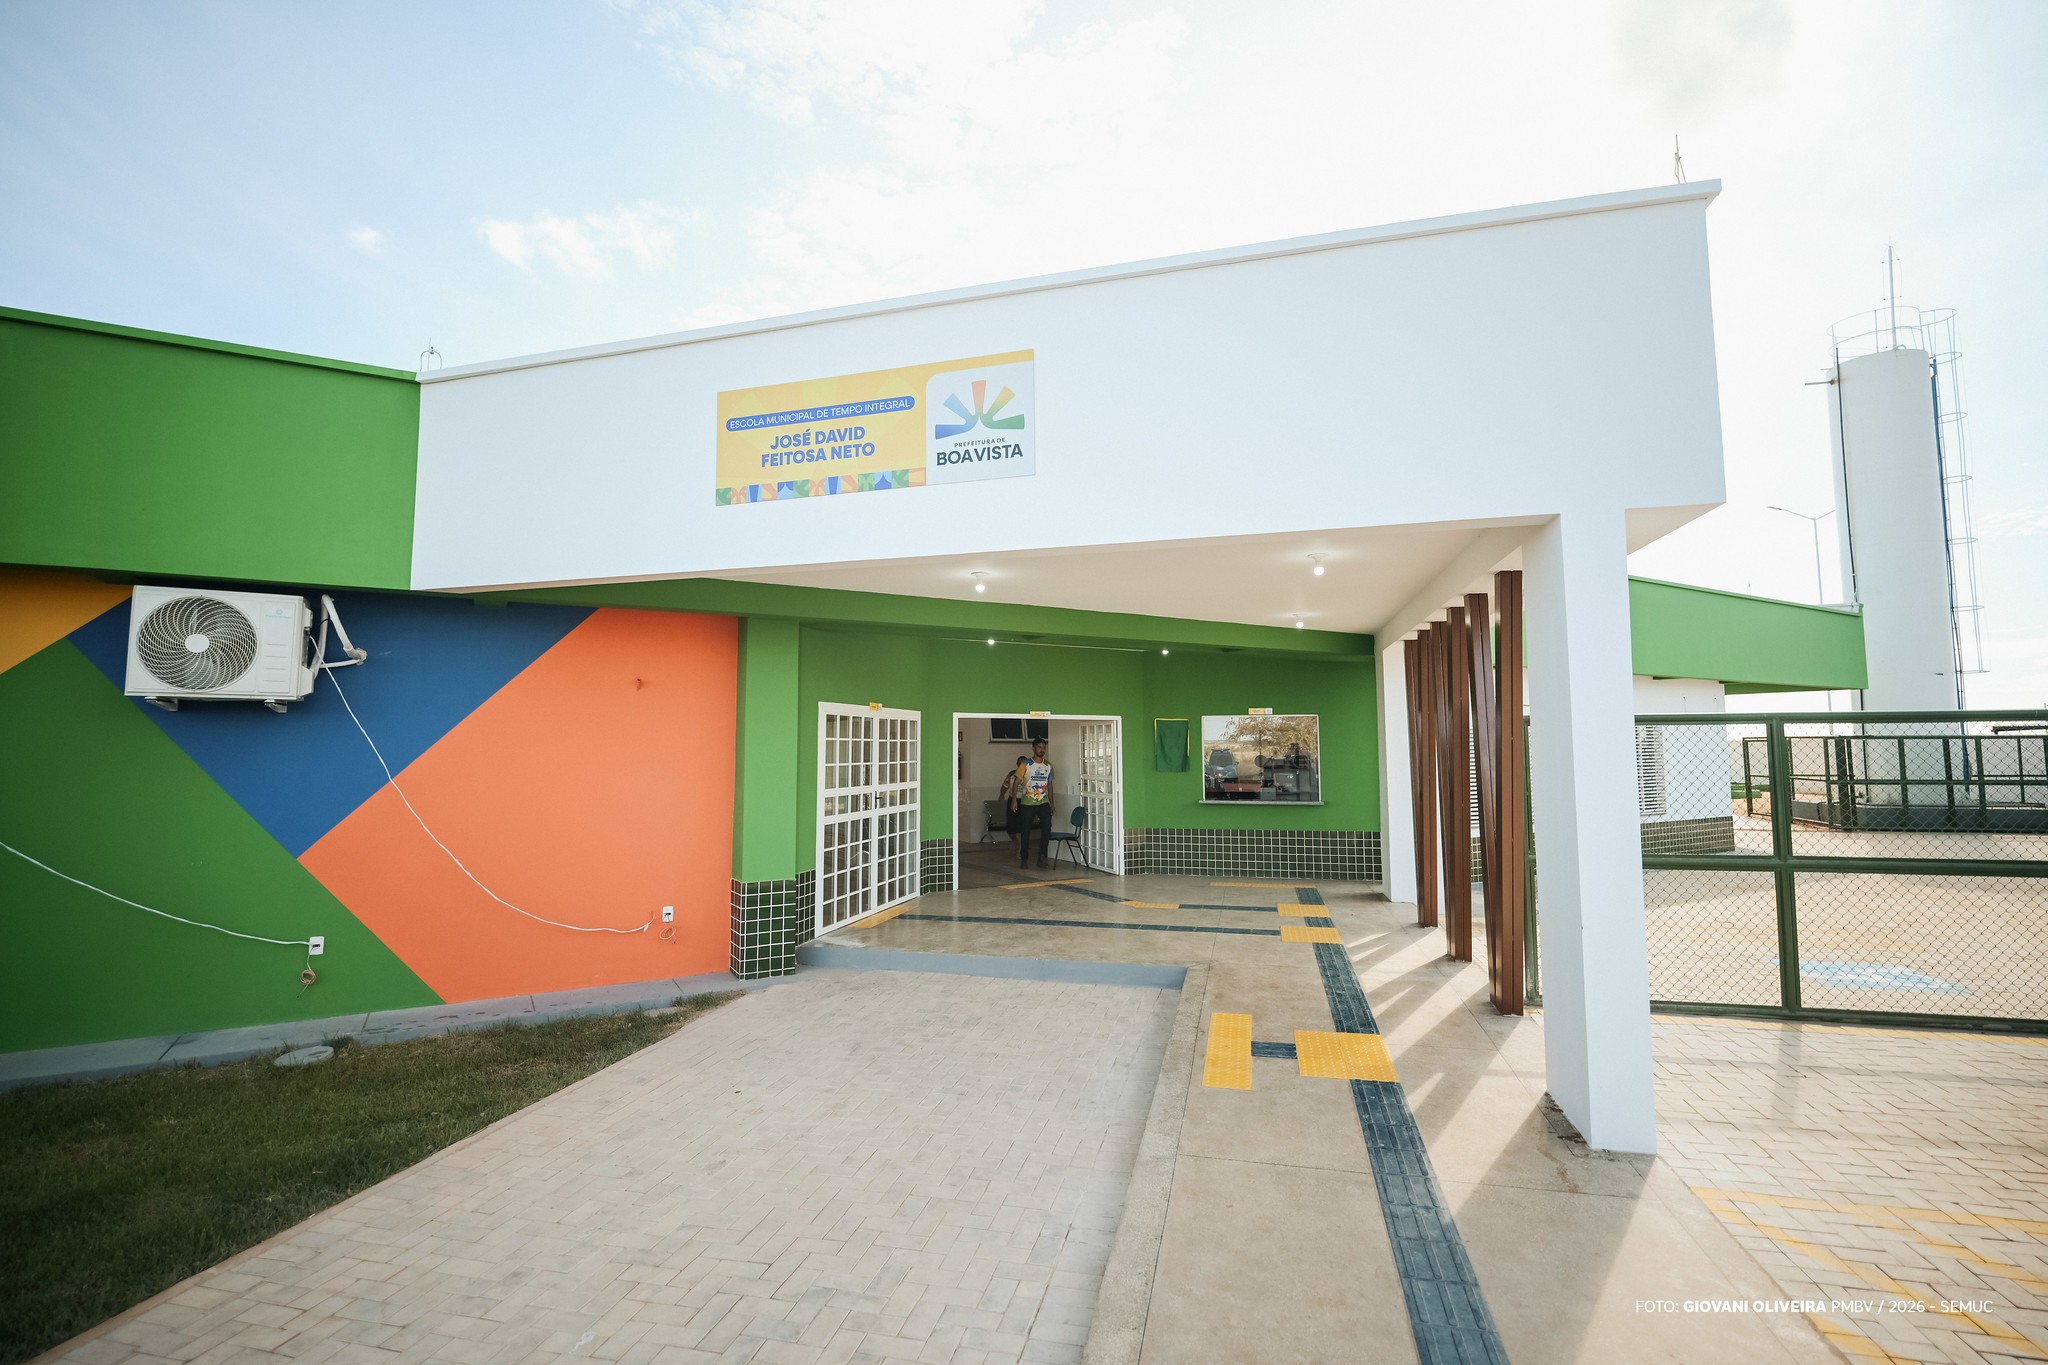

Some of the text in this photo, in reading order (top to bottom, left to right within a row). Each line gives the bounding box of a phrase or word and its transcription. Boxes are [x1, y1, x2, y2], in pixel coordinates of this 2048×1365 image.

[730, 399, 910, 429] ESCOLA MUNICIPAL DE TEMPO INTEGRAL
[770, 426, 866, 450] JOSÉ DAVID
[954, 439, 996, 448] PREFEITURA
[761, 442, 876, 468] FEITOSA NETO
